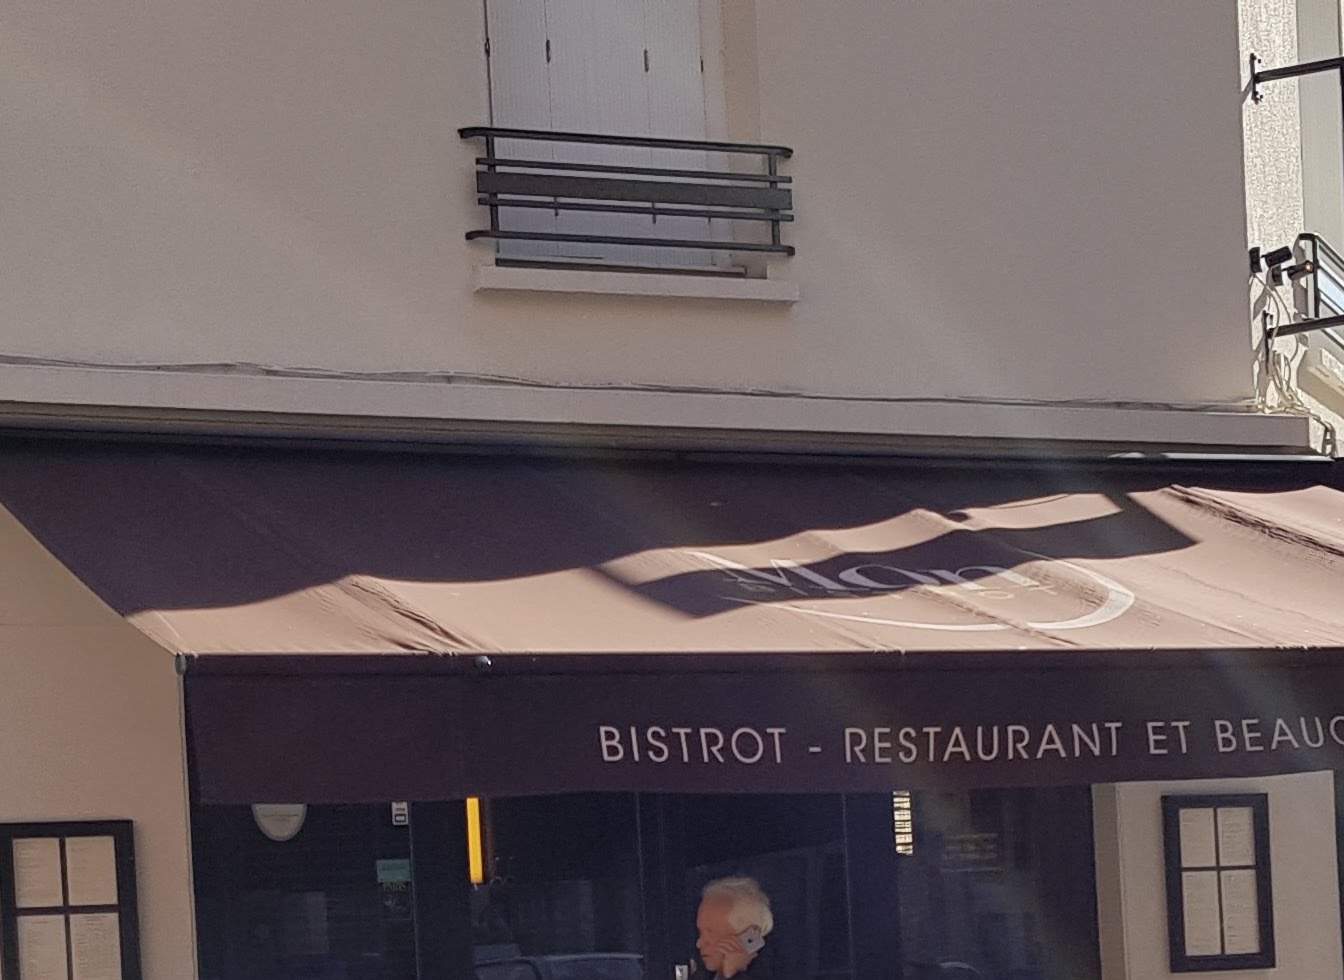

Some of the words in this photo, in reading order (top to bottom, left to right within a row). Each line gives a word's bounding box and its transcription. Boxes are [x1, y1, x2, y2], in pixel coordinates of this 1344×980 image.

[599, 725, 787, 764] BISTROT
[844, 721, 1123, 763] RESTAURANT
[1146, 720, 1191, 756] ET
